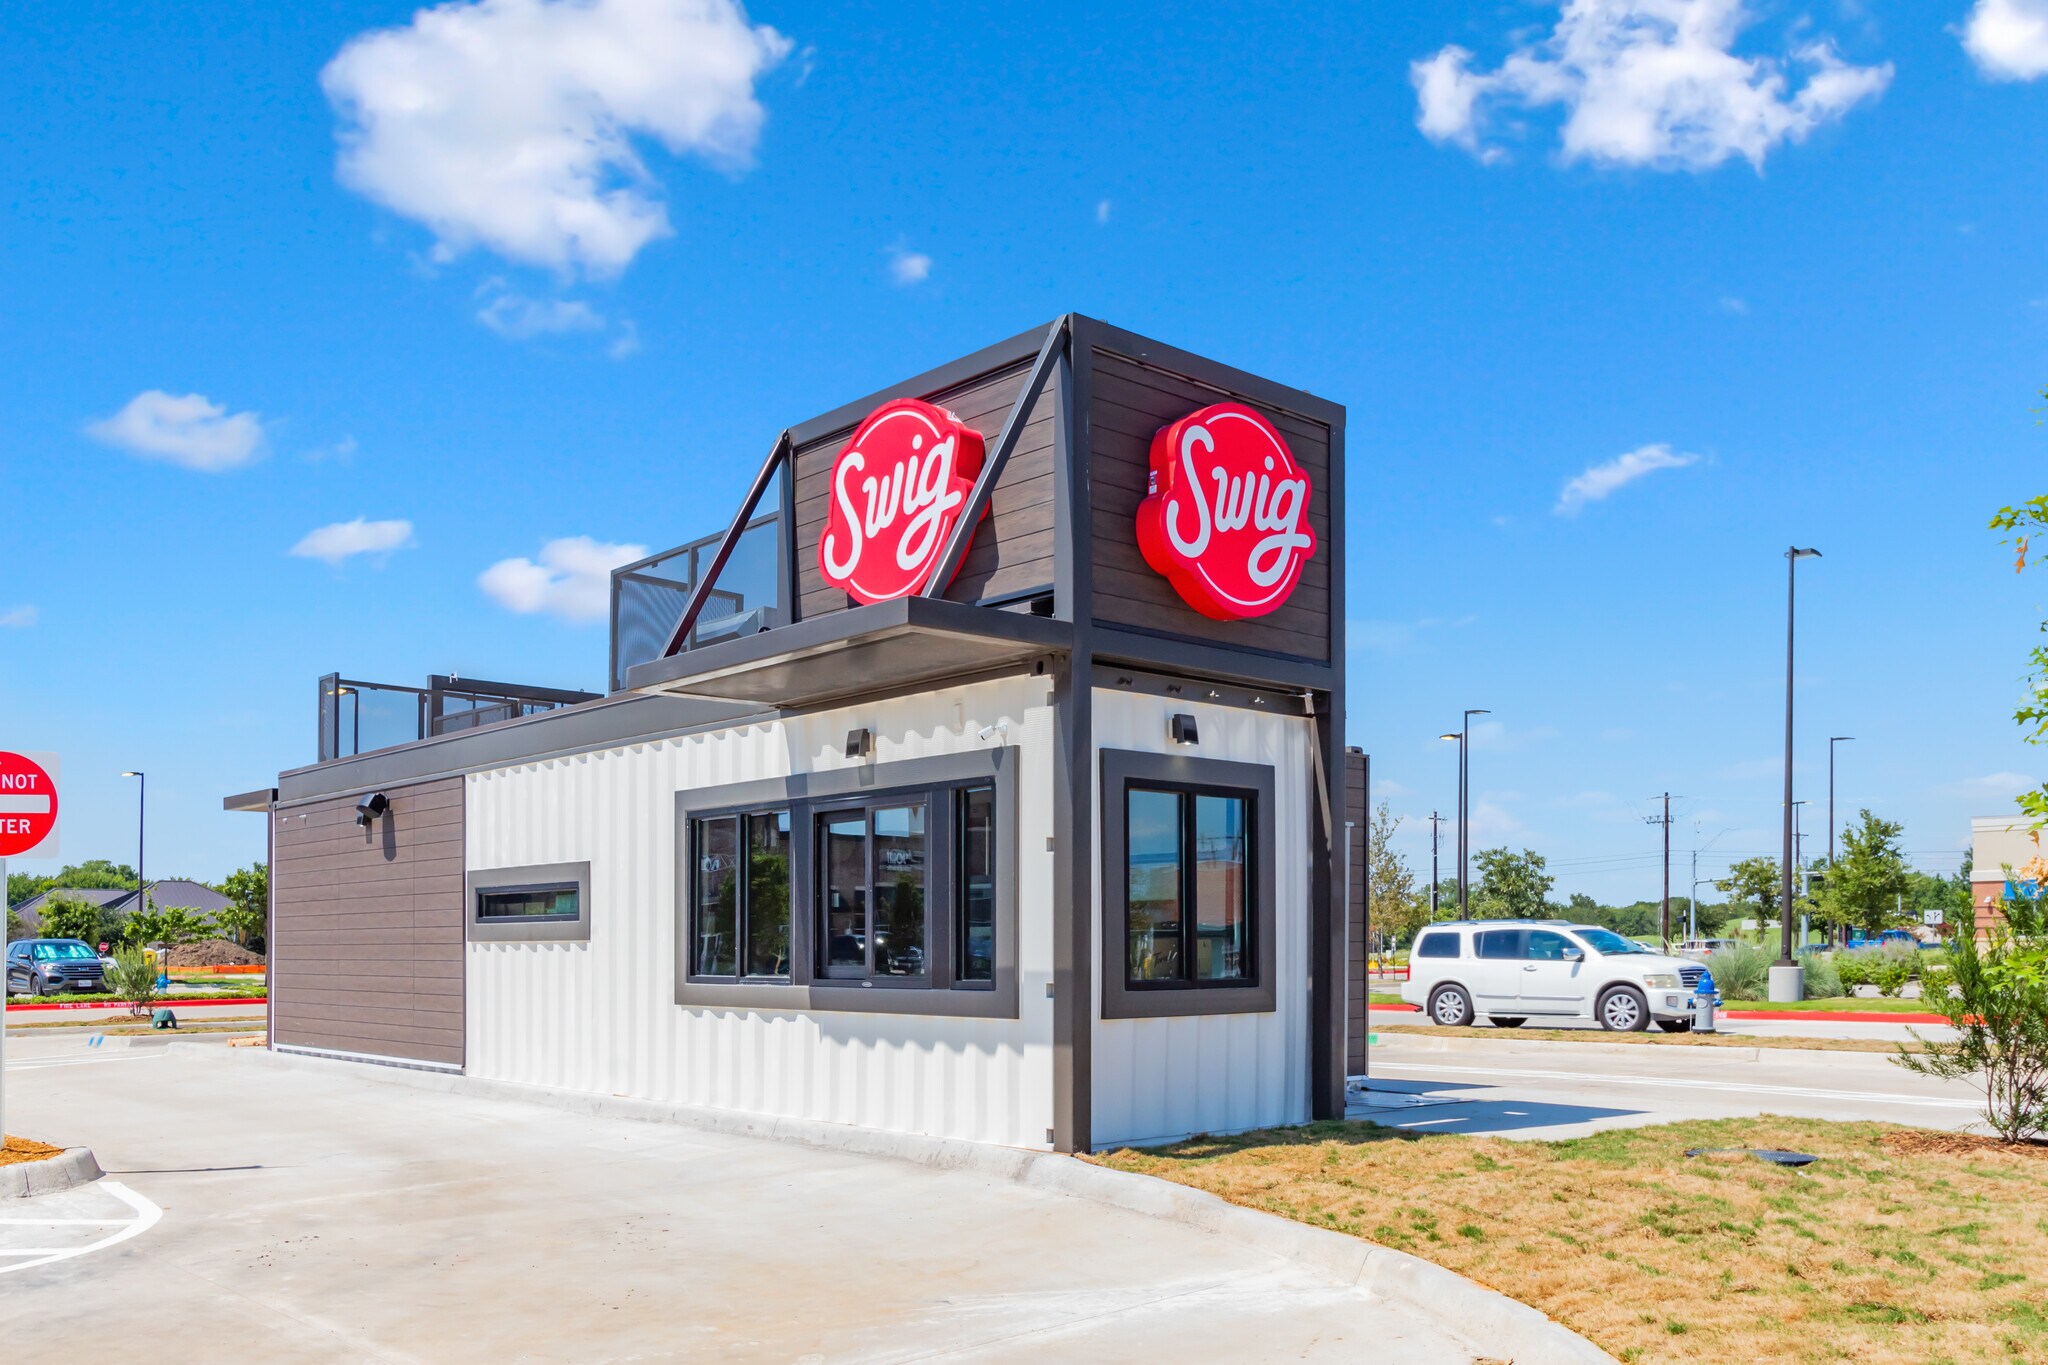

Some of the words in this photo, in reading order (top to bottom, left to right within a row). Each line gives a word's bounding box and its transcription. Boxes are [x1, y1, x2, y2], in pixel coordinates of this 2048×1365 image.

[824, 433, 962, 580] Swig
[1166, 424, 1312, 588] Swig
[1, 773, 38, 790] NOT
